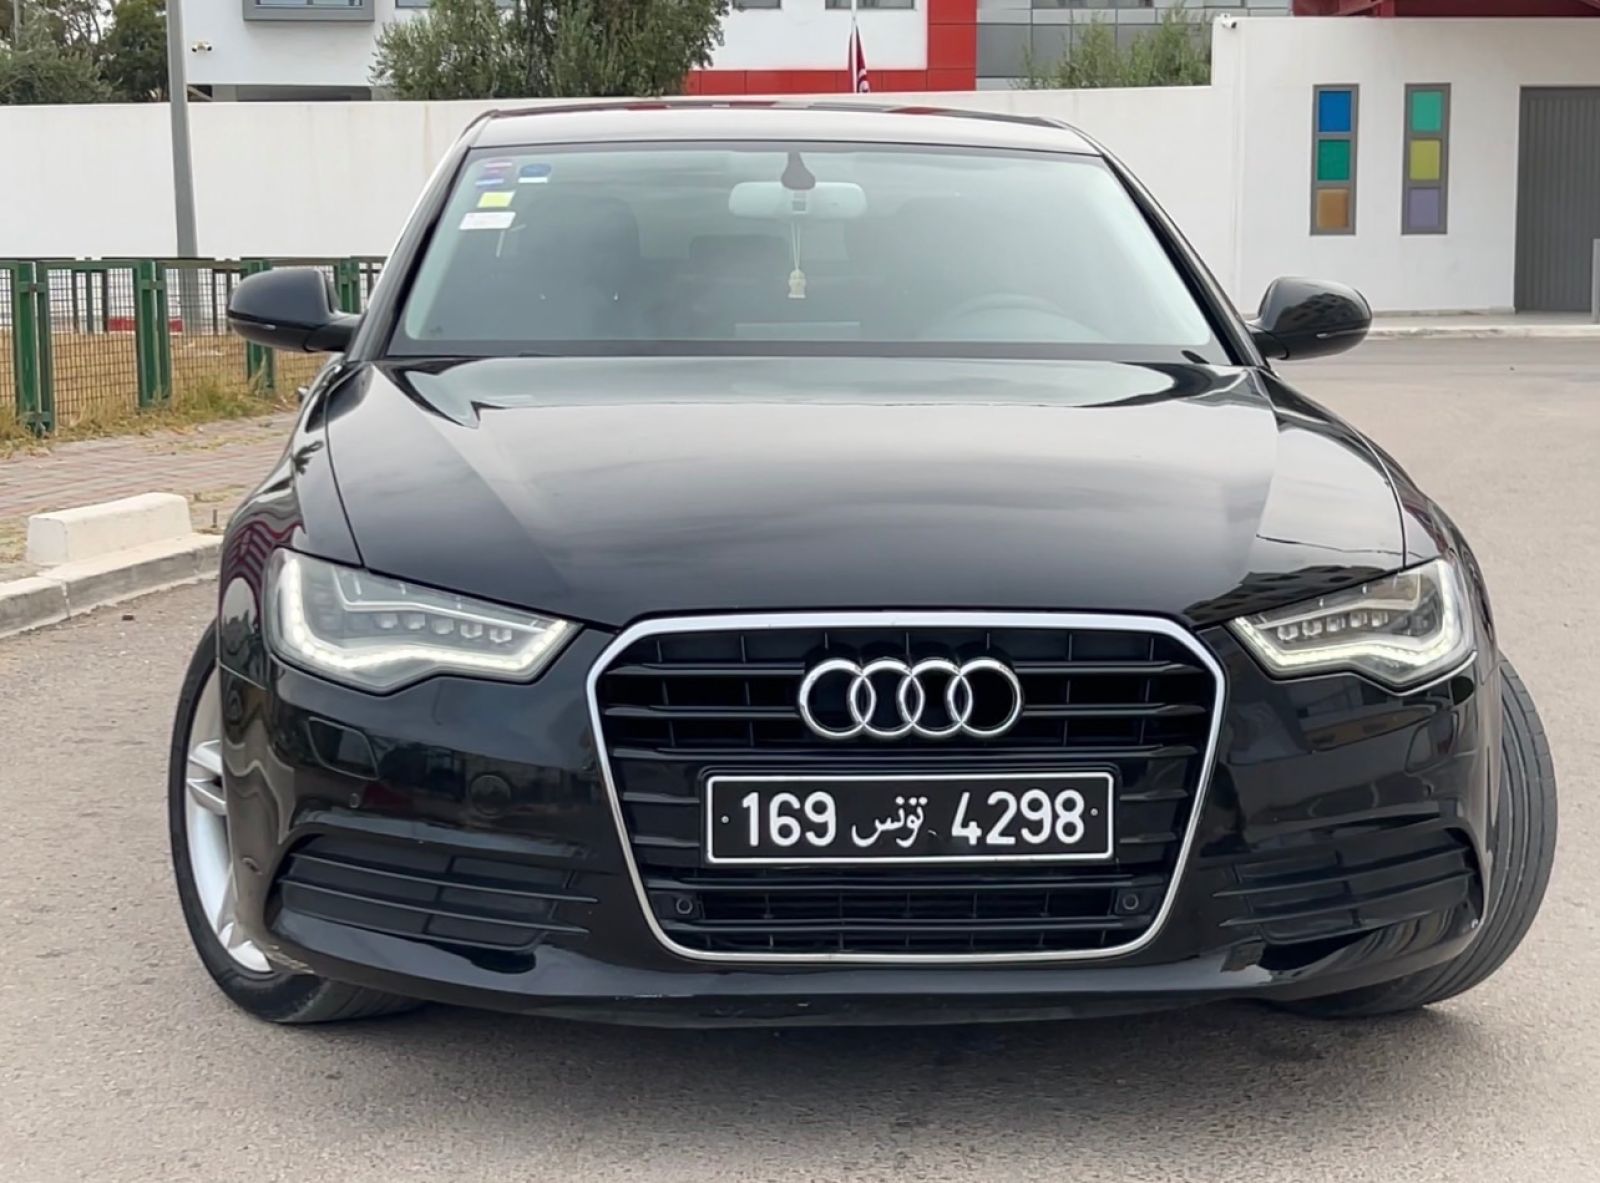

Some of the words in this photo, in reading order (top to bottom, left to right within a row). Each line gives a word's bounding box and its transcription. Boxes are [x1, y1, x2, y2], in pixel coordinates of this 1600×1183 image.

[741, 790, 837, 848] 169
[851, 796, 928, 848] تونس
[950, 788, 1086, 847] 4298
